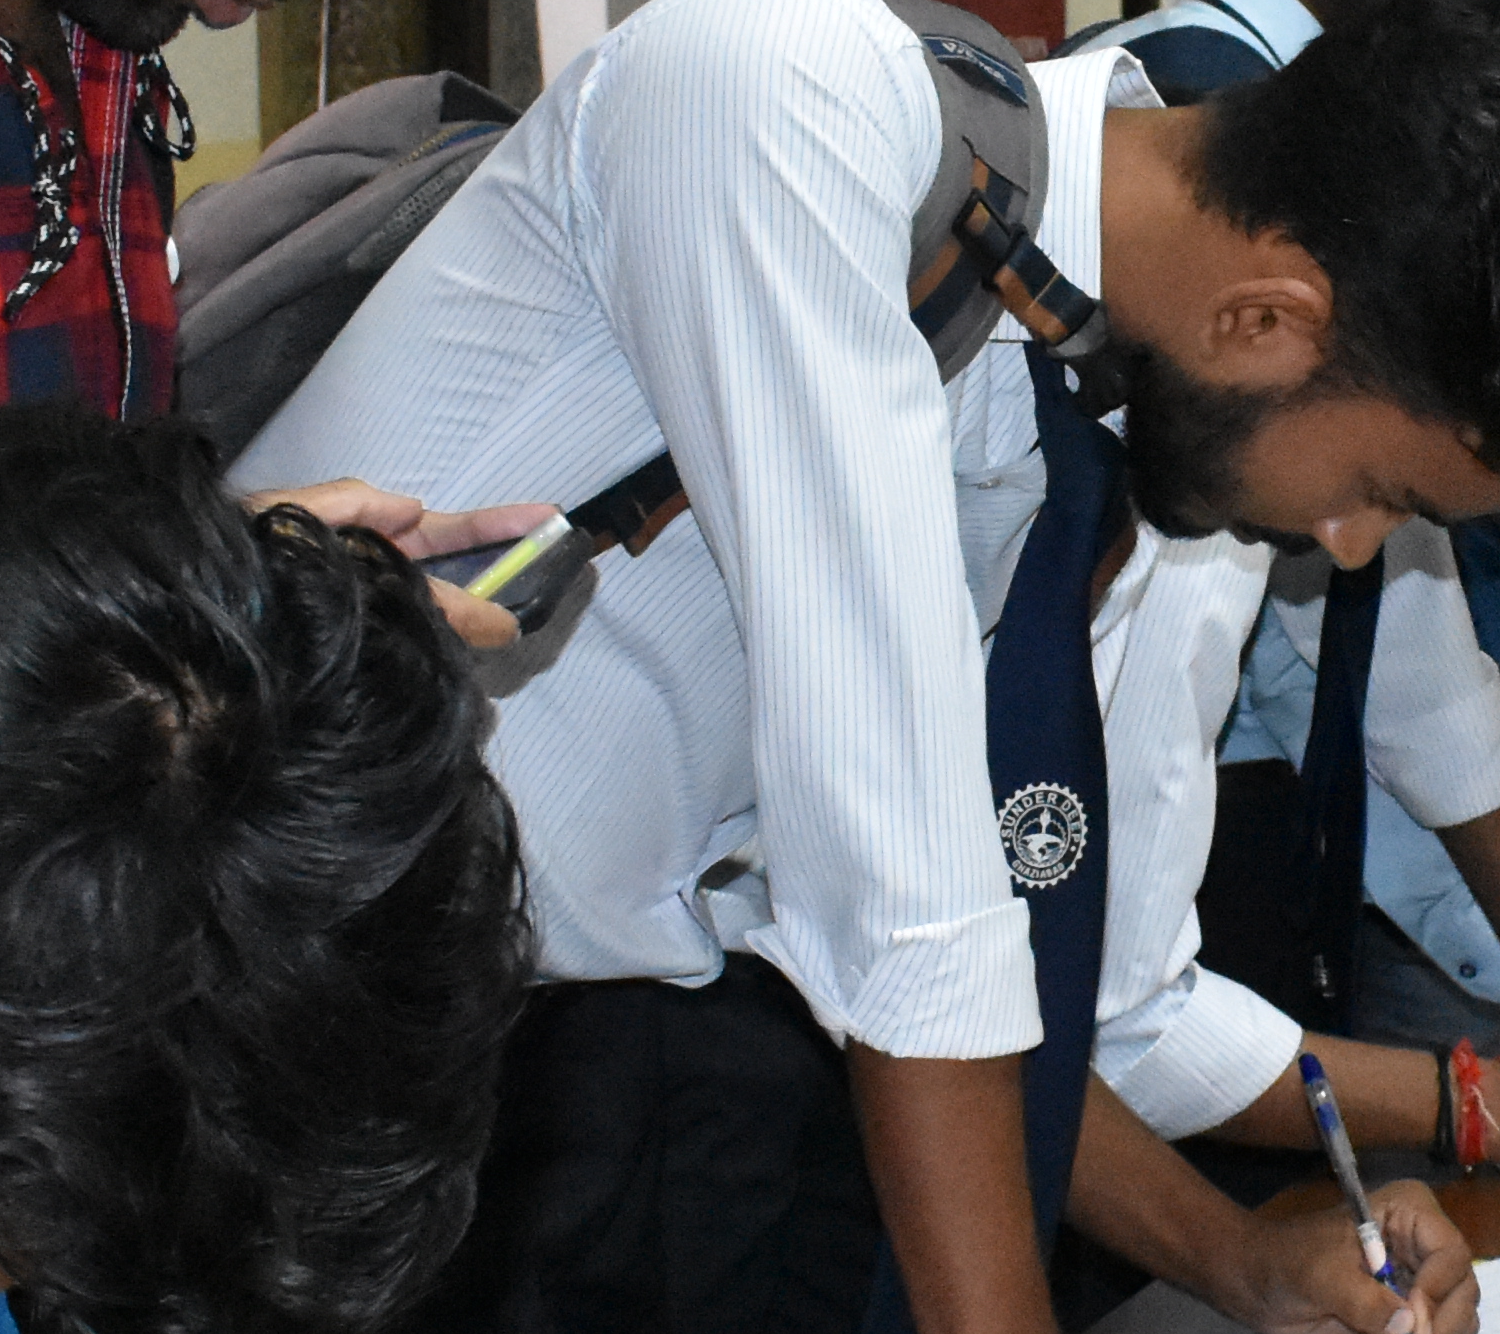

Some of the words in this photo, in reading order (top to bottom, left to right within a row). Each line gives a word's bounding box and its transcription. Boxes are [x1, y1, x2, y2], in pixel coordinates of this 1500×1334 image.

[1001, 791, 1057, 838] SUNDER
[1061, 800, 1081, 842] DEEP
[1012, 858, 1066, 879] GHAZIABAD
